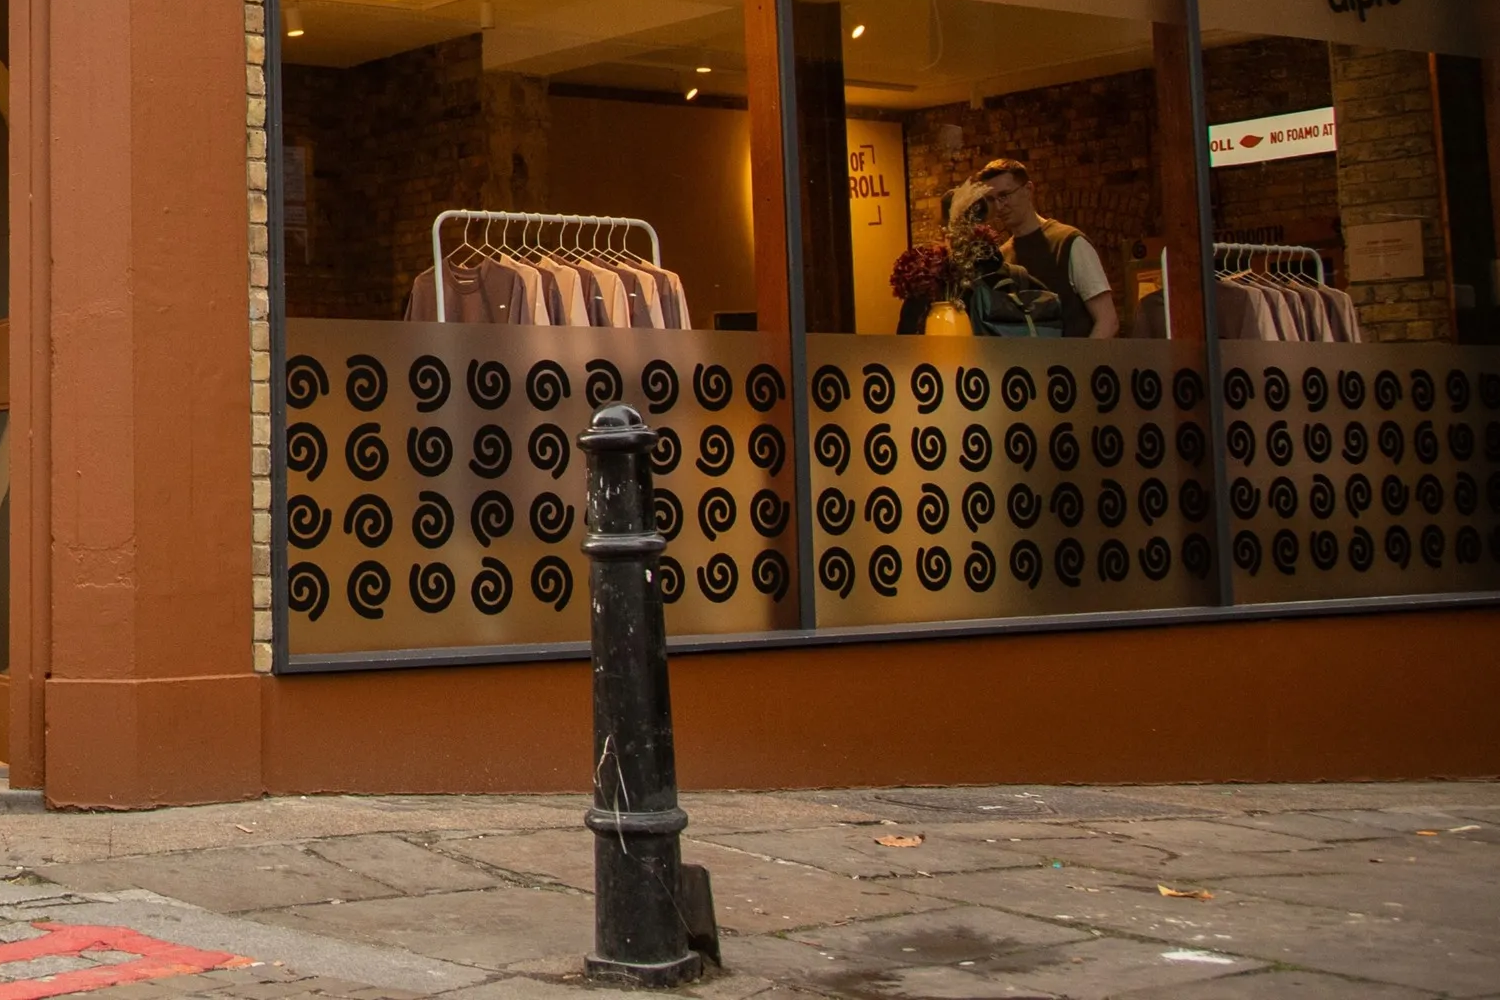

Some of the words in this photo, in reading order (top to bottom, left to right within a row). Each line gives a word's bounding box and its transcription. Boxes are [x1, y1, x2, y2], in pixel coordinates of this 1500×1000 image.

[1210, 139, 1234, 152] OLL
[1269, 131, 1284, 144] NO
[1286, 125, 1319, 141] FOAMO
[1322, 123, 1334, 136] AT
[850, 152, 865, 172] OF
[849, 174, 890, 198] ROLL
